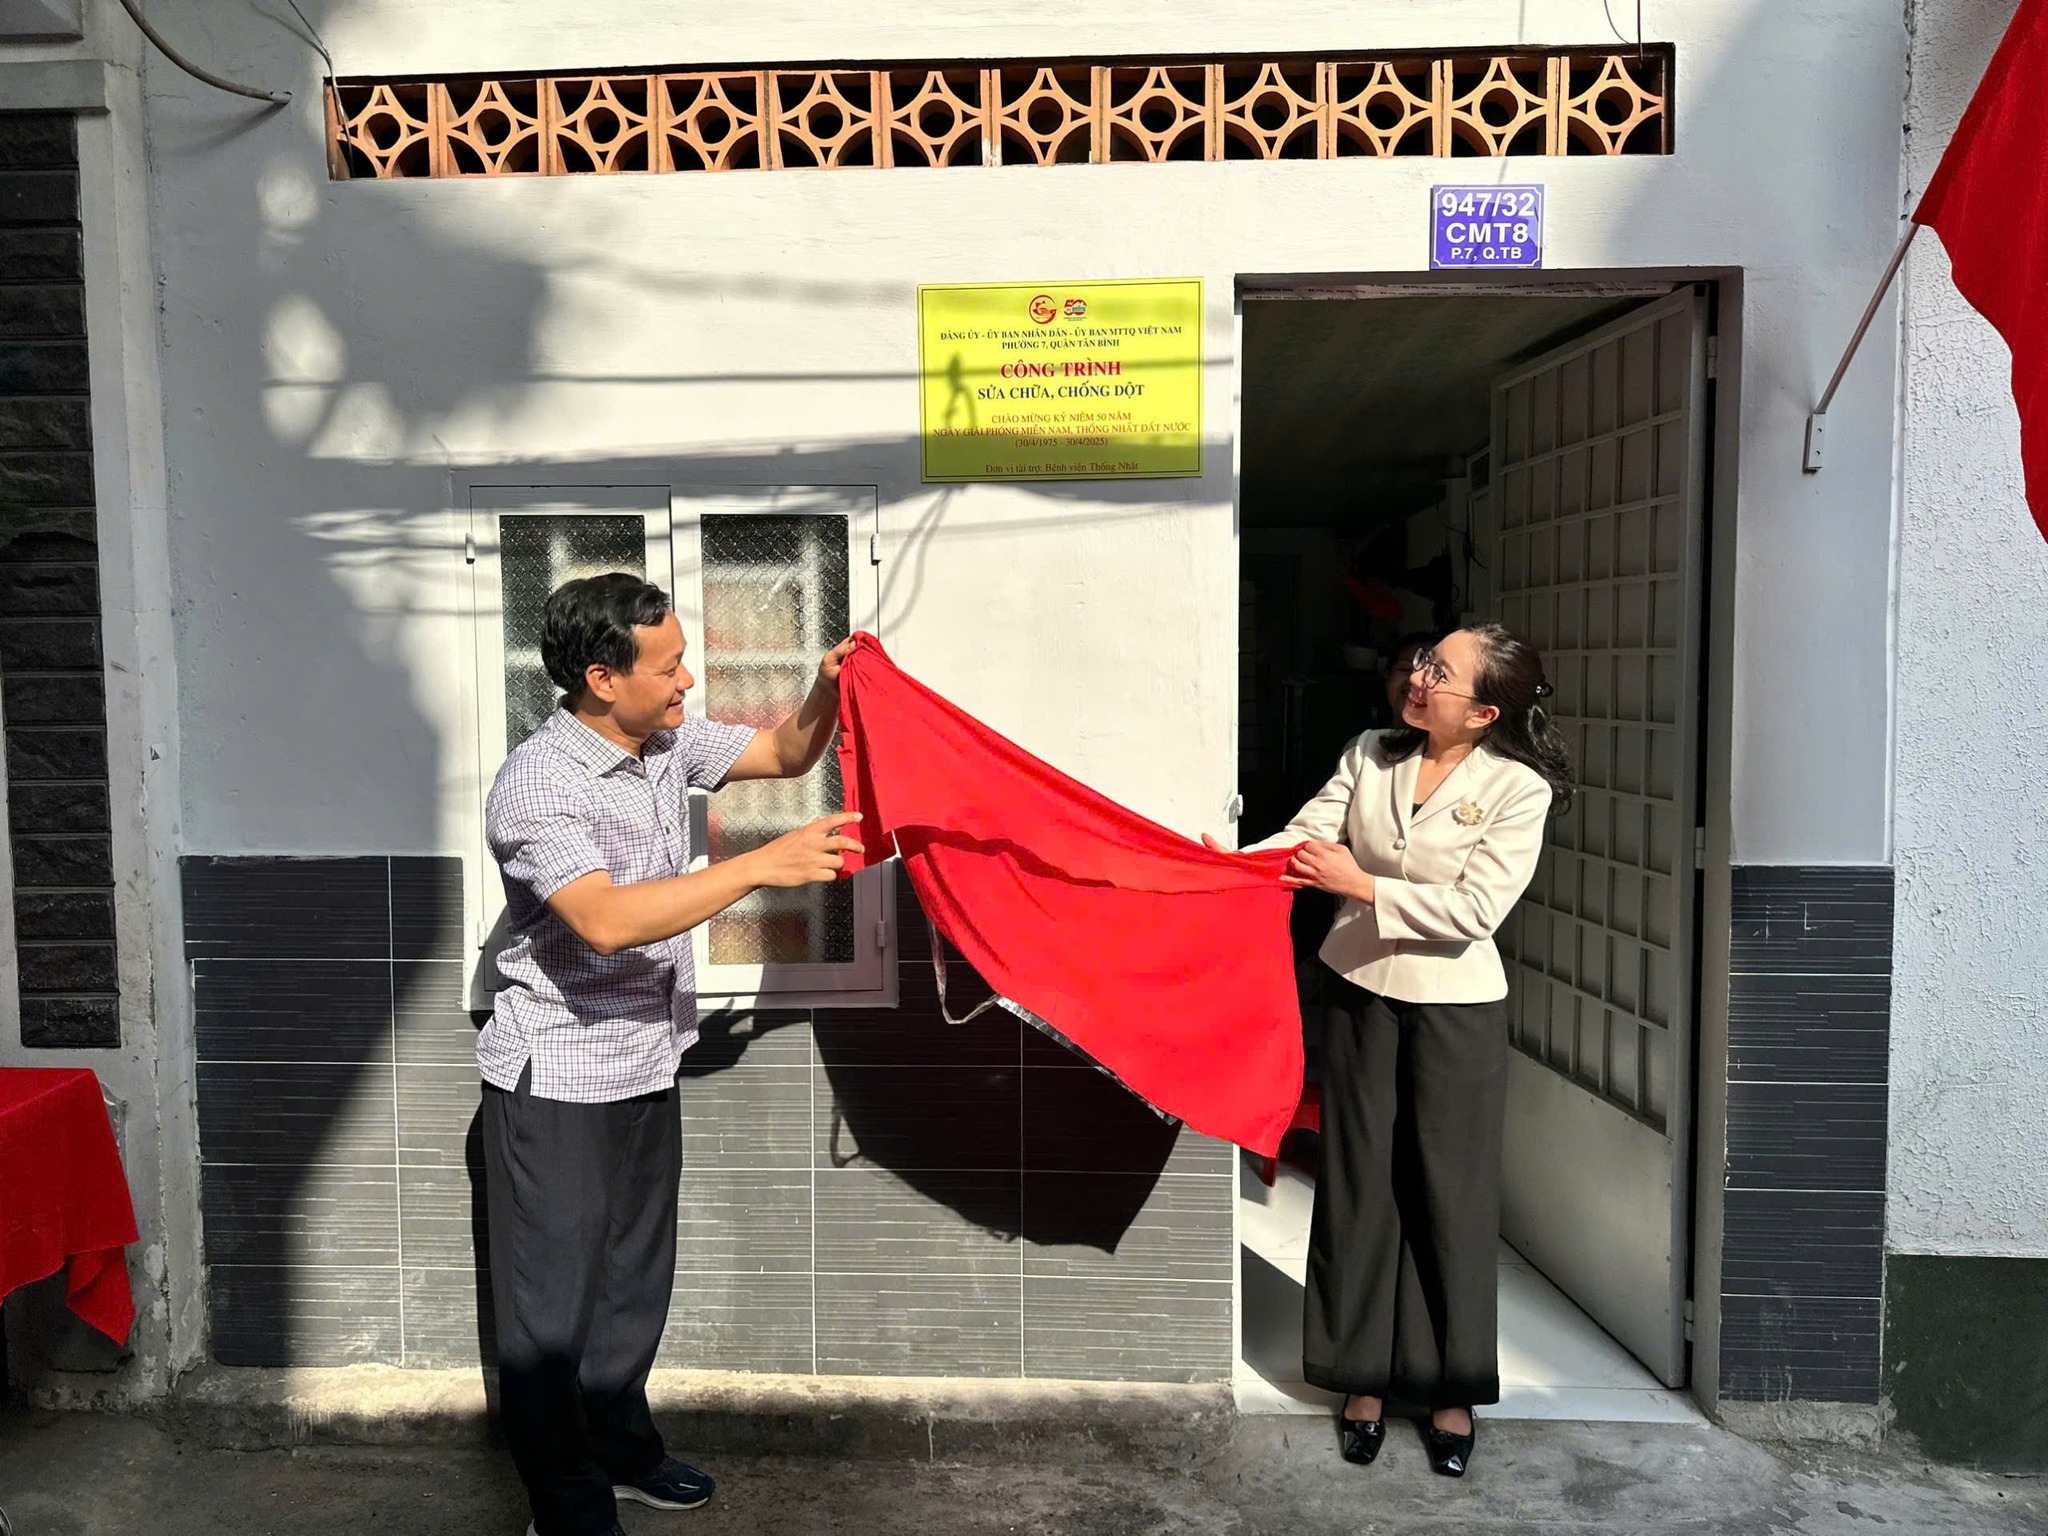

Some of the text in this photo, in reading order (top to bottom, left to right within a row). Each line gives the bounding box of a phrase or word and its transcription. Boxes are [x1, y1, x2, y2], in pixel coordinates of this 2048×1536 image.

[1441, 192, 1535, 217] 947/32
[1446, 222, 1529, 244] CMT8
[1451, 247, 1522, 262] P.7, Q.TB
[941, 330, 965, 340] ĐẢNG
[1001, 331, 1019, 339] BAN
[1021, 328, 1047, 338] NHÂN
[1049, 328, 1067, 337] DÂN
[1089, 328, 1107, 336] BAN
[1110, 327, 1136, 337] MTTQ
[1138, 325, 1159, 335] VIỆT
[1161, 326, 1182, 334] NAM
[1050, 340, 1075, 349] QUẬN
[1078, 338, 1095, 347] TÂN
[1097, 338, 1120, 347] BÌNH
[1001, 357, 1121, 378] CÔNG TRÌNH
[978, 380, 1145, 399] SỬA CHỮA, CHỐNG DỘT
[991, 414, 1019, 423] CHÀO
[1022, 413, 1051, 423] MỪNG
[1096, 413, 1106, 421] 50
[1108, 411, 1131, 421] NĂM
[933, 427, 961, 437] NGÀY
[985, 426, 1019, 436] PHÓNG
[1048, 426, 1073, 435] NAM,
[1076, 422, 1109, 434] THỐNG
[1112, 422, 1139, 433] NHẤT
[1141, 421, 1161, 432] ĐẤT
[1163, 420, 1191, 431] NƯỚC
[1015, 438, 1057, 448] (30/4/1975
[1065, 437, 1108, 447] 30/4/2025)
[985, 464, 1003, 473] Đơn
[1016, 464, 1026, 473] tài
[1045, 463, 1066, 472] Bệnh
[1069, 463, 1087, 472] viện
[1089, 462, 1116, 473] Thống
[1118, 461, 1139, 471] Nhất
